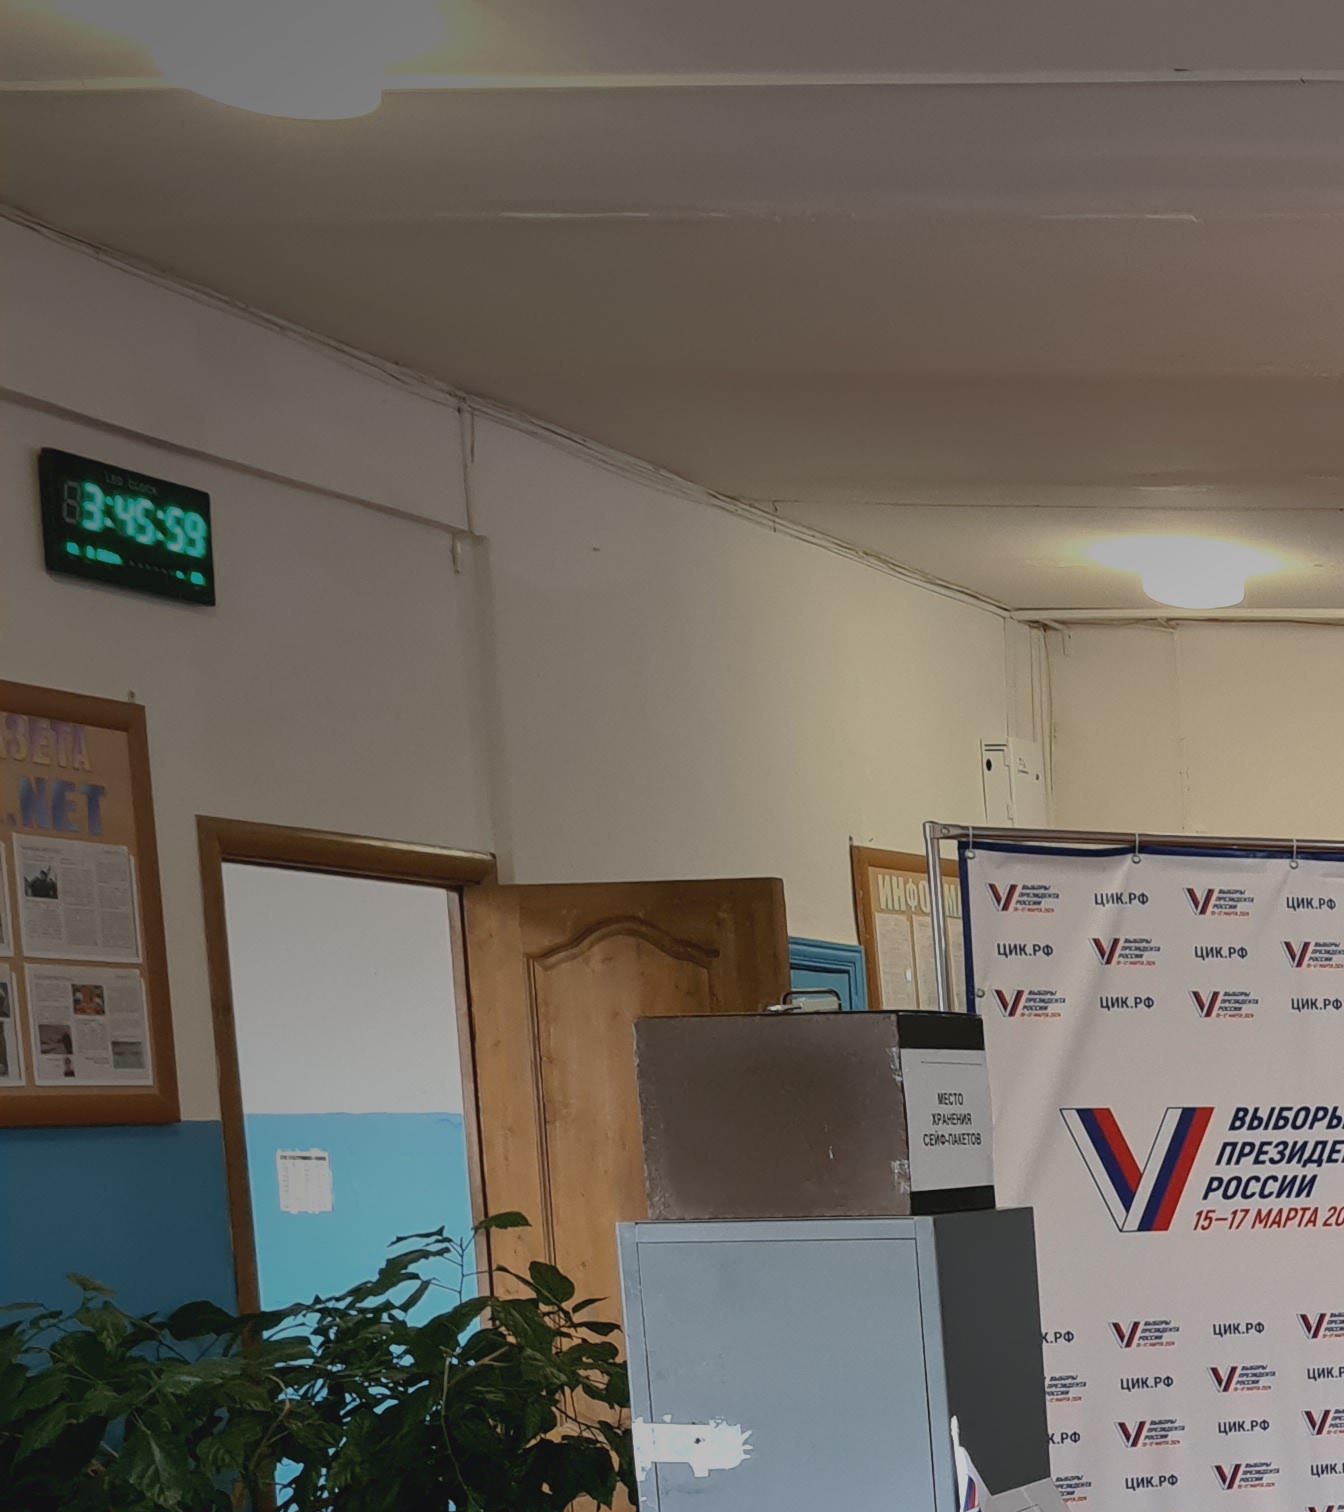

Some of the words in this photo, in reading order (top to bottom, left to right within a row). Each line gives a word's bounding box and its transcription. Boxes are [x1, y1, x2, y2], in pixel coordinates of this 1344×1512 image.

[1095, 892, 1148, 907] ЦИК.РФ
[1287, 897, 1336, 911] ЦИК.РФ
[997, 943, 1053, 958] ЦИК.РФ
[1195, 946, 1248, 961] ЦИК.РФ
[1100, 996, 1154, 1011] ЦИК.РФ
[1291, 998, 1342, 1012] ЦИК.РФ
[937, 1092, 964, 1106] МЕСТО
[931, 1113, 973, 1126] ХРАНЕНИЯ
[923, 1130, 982, 1147] СЕЙФ-ПАКЕТОВ
[1202, 1174, 1318, 1200] РОССИИ
[1251, 1207, 1319, 1230] МАРТА
[1213, 1322, 1264, 1338] ЦИК.РФ
[1121, 1376, 1173, 1392] ЦИК.РФ
[1218, 1420, 1269, 1435] ЦИК.РФ
[1125, 1474, 1178, 1491] ЦИК.РФ
